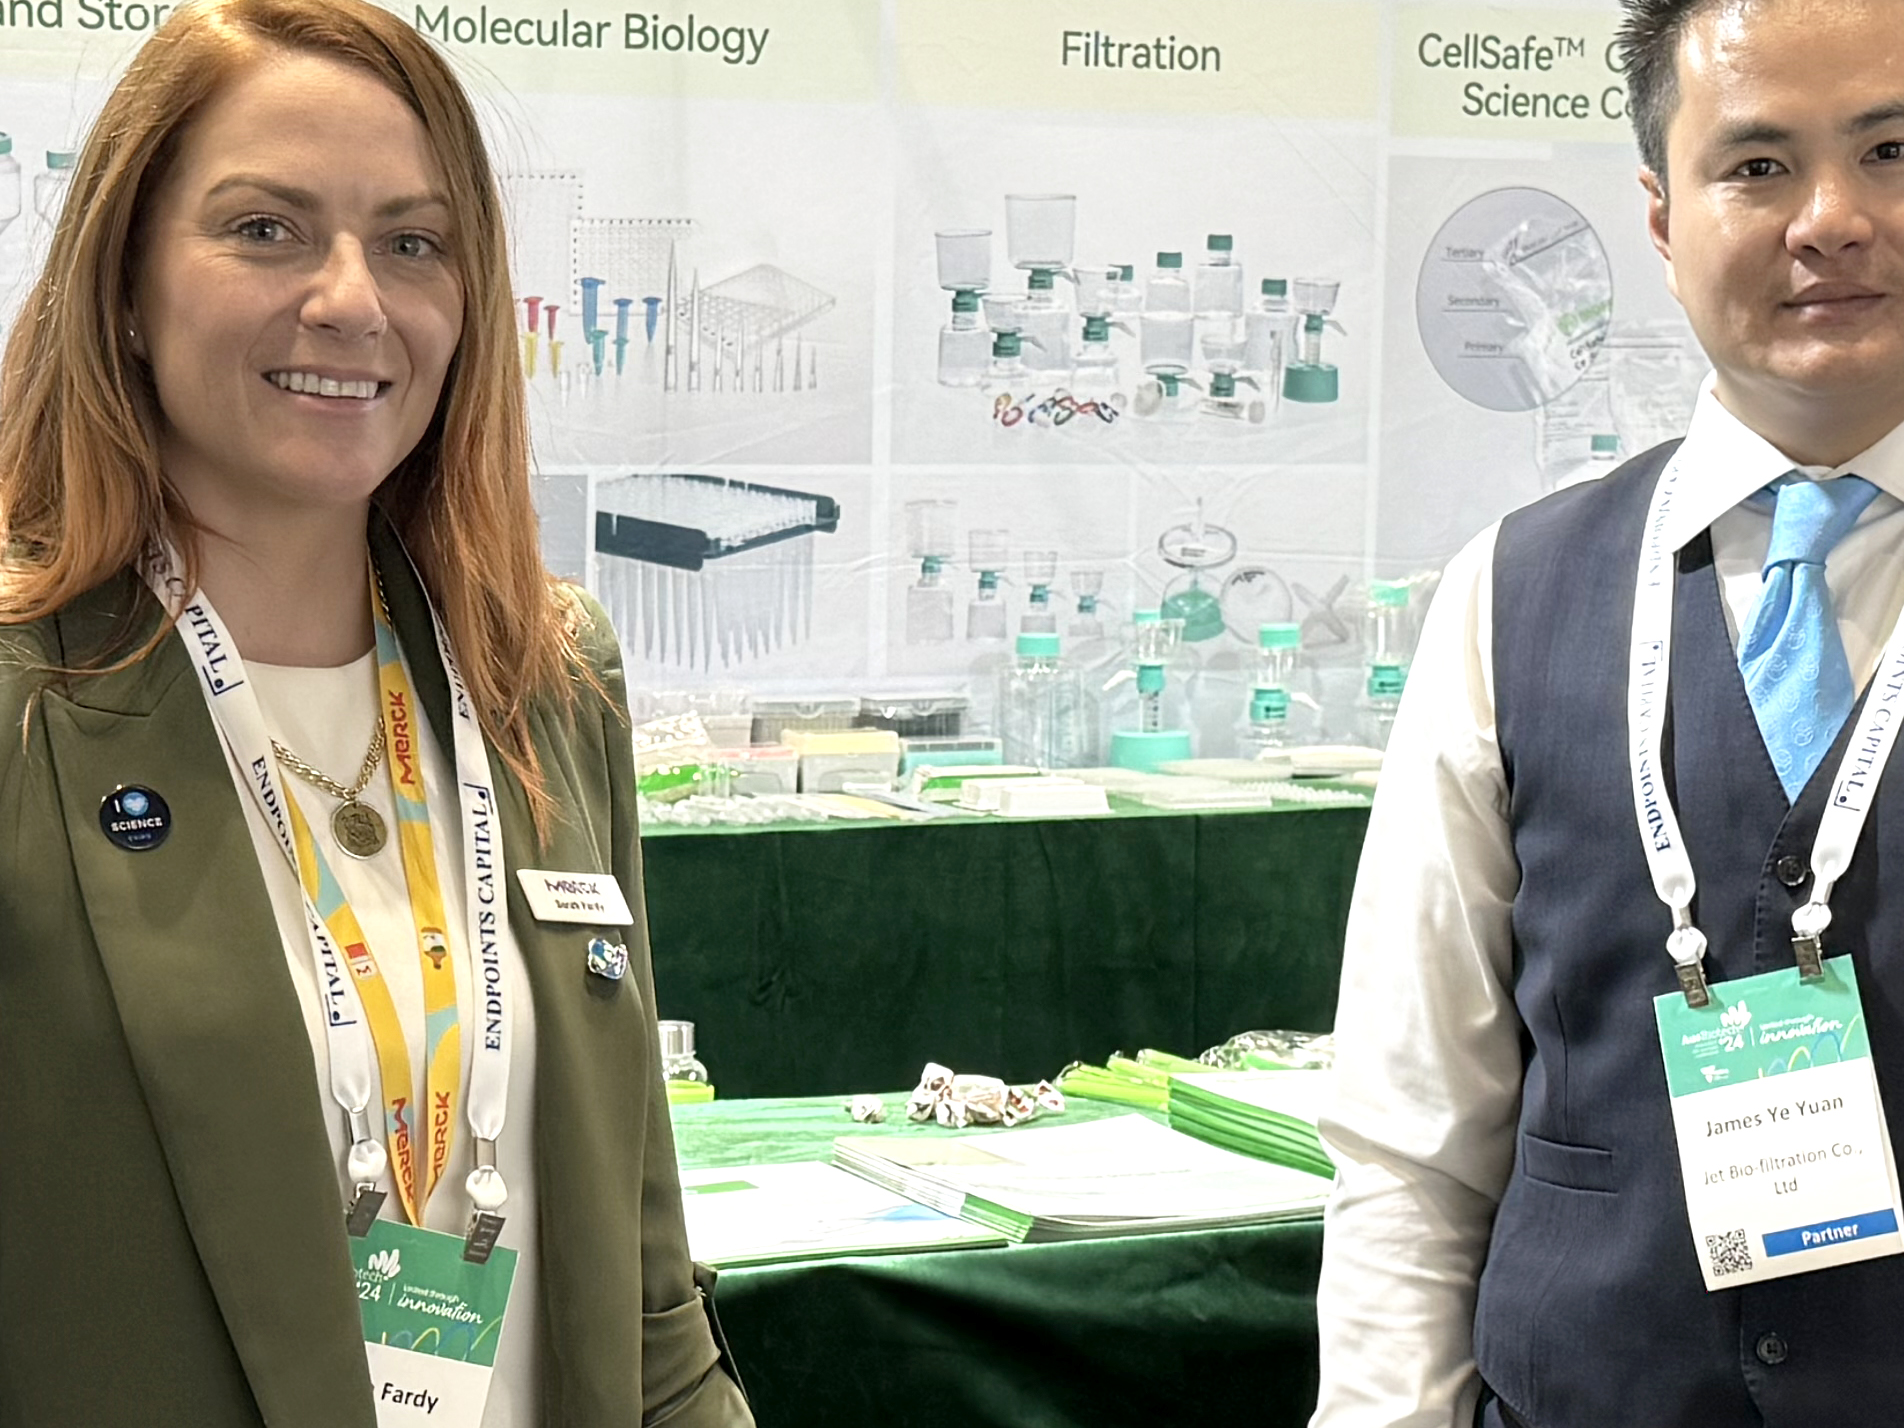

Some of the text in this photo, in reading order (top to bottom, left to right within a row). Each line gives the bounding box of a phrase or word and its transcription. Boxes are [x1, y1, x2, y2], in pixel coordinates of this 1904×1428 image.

[415, 4, 770, 65] Molecular Biology
[1062, 30, 1221, 72] Filtration
[1462, 81, 1590, 118] Science
[1846, 708, 1892, 792] CAPITAL
[111, 817, 163, 832] SCIENCE
[471, 802, 502, 1052] ENDPOINTS CAPITAL
[1706, 1096, 1844, 1137] James Ye Yuan
[1704, 1169, 1725, 1186] Jet
[1730, 1148, 1827, 1179] Bio-filtration
[1774, 1178, 1798, 1196] Ltd
[1801, 1222, 1859, 1247] Partner
[397, 1293, 484, 1324] innovation
[381, 1382, 439, 1414] Fardy
